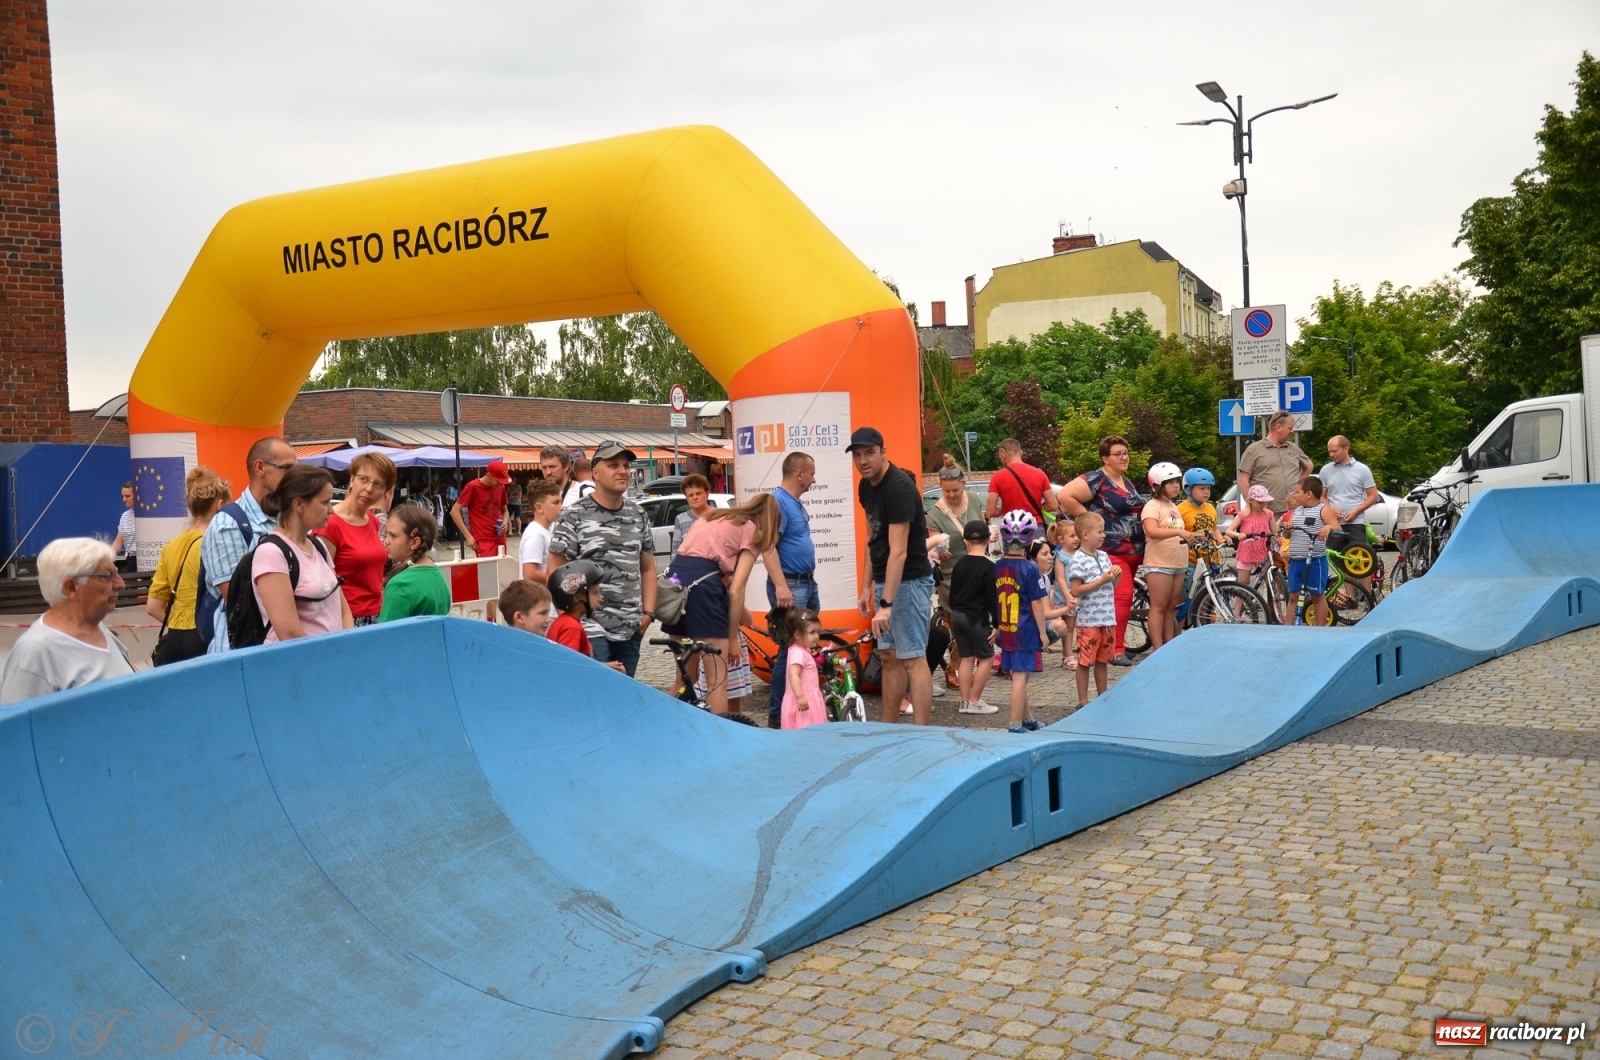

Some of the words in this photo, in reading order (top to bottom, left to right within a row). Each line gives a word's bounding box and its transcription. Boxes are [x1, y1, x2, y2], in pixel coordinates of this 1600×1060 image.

[282, 232, 384, 275] MIASTO
[392, 206, 549, 260] RACIBÓRZ
[1284, 381, 1305, 410] P
[802, 425, 808, 436] 3
[815, 424, 830, 436] Cel
[832, 424, 839, 435] 3
[998, 591, 1020, 624] 11
